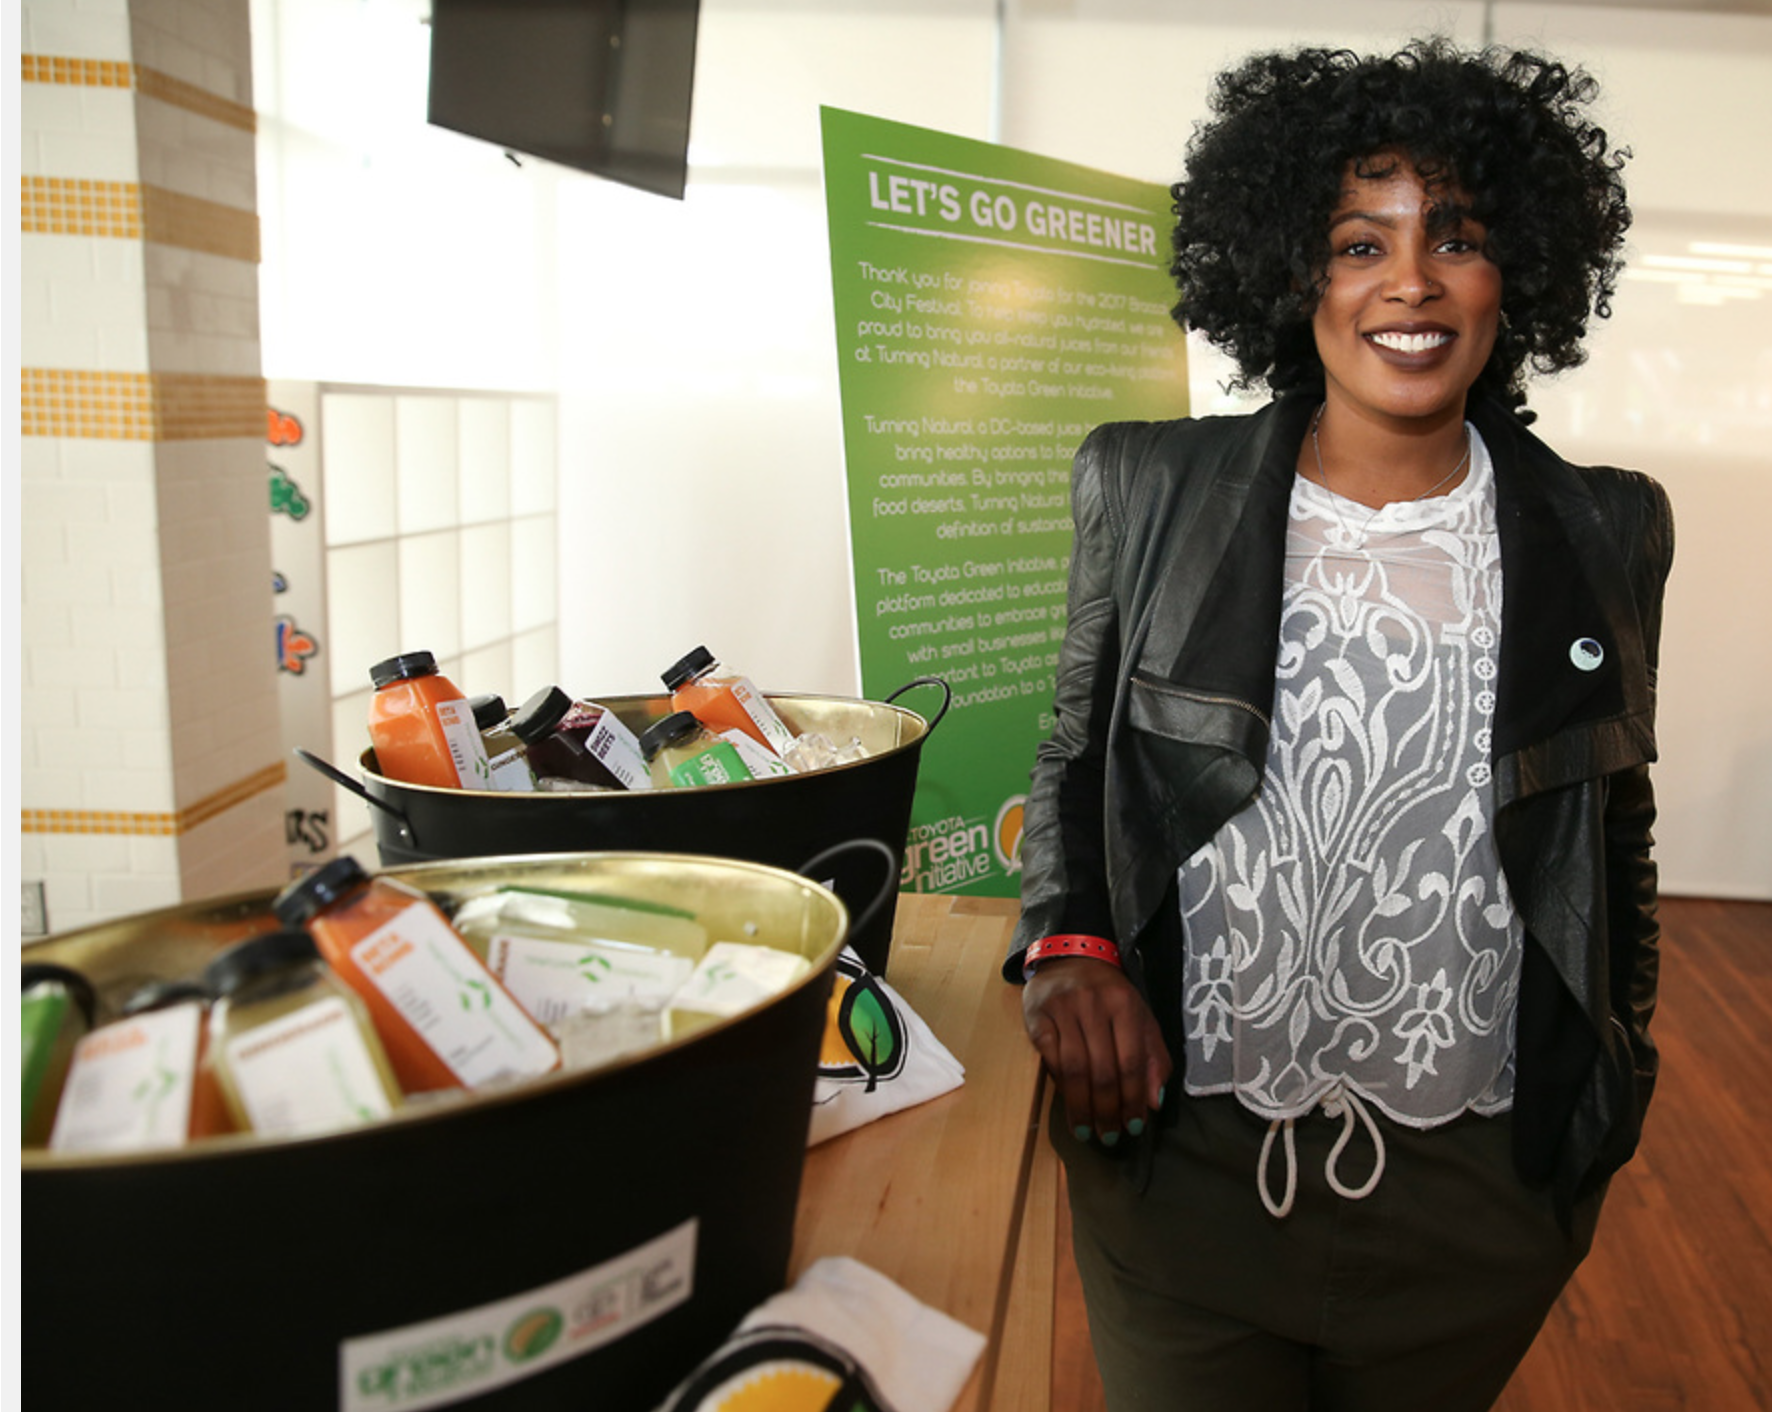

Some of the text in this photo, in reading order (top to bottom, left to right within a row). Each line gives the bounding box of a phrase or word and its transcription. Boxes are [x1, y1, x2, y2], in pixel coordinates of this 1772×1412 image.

[869, 171, 1157, 256] LET'S GO GREENER
[857, 261, 909, 285] Thank
[911, 272, 941, 289] you
[943, 271, 963, 290] for
[870, 289, 903, 314] City
[965, 299, 984, 318] To
[1051, 313, 1074, 329] you
[857, 319, 904, 338] proud
[906, 320, 922, 338] to
[925, 321, 962, 345] bring
[964, 328, 991, 346] you
[1059, 336, 1092, 354] juices
[1094, 336, 1118, 354] from
[1120, 343, 1138, 357] our
[854, 345, 872, 363] at
[875, 344, 930, 369] Turning
[988, 356, 998, 370] a
[1000, 358, 1045, 373] partner
[1047, 357, 1061, 374] of
[1063, 361, 1083, 374] our
[952, 375, 979, 393] the
[980, 377, 1026, 399] Toyota
[1028, 379, 1065, 397] Green
[863, 414, 919, 437] Turning
[977, 420, 988, 436] a
[989, 416, 1054, 436] DC-based
[1055, 421, 1083, 438] juice
[894, 442, 933, 464] bring
[935, 442, 988, 463] healthy
[991, 444, 1038, 461] options
[1039, 443, 1054, 460] to
[971, 467, 993, 489] By
[994, 468, 1046, 488] bringing
[872, 496, 908, 518] food
[969, 492, 1019, 514] Turning
[1020, 492, 1065, 509] Natural
[936, 519, 998, 540] definition
[1000, 516, 1015, 537] of
[876, 567, 907, 586] The
[909, 563, 960, 585] Toyota
[962, 559, 1005, 579] Green
[876, 592, 936, 617] platform
[938, 586, 1004, 606] dedicated
[1006, 582, 1021, 600] to
[888, 612, 975, 640] communities
[976, 610, 992, 629] to
[994, 606, 1047, 626] embrace
[906, 643, 939, 664] with
[941, 632, 976, 659] small
[977, 630, 1047, 653] businesses
[981, 661, 997, 678] to
[1000, 654, 1042, 675] Toyota
[1020, 678, 1034, 695] to
[1036, 678, 1046, 692] a
[910, 815, 966, 840] TOYOTA
[900, 824, 989, 885] green
